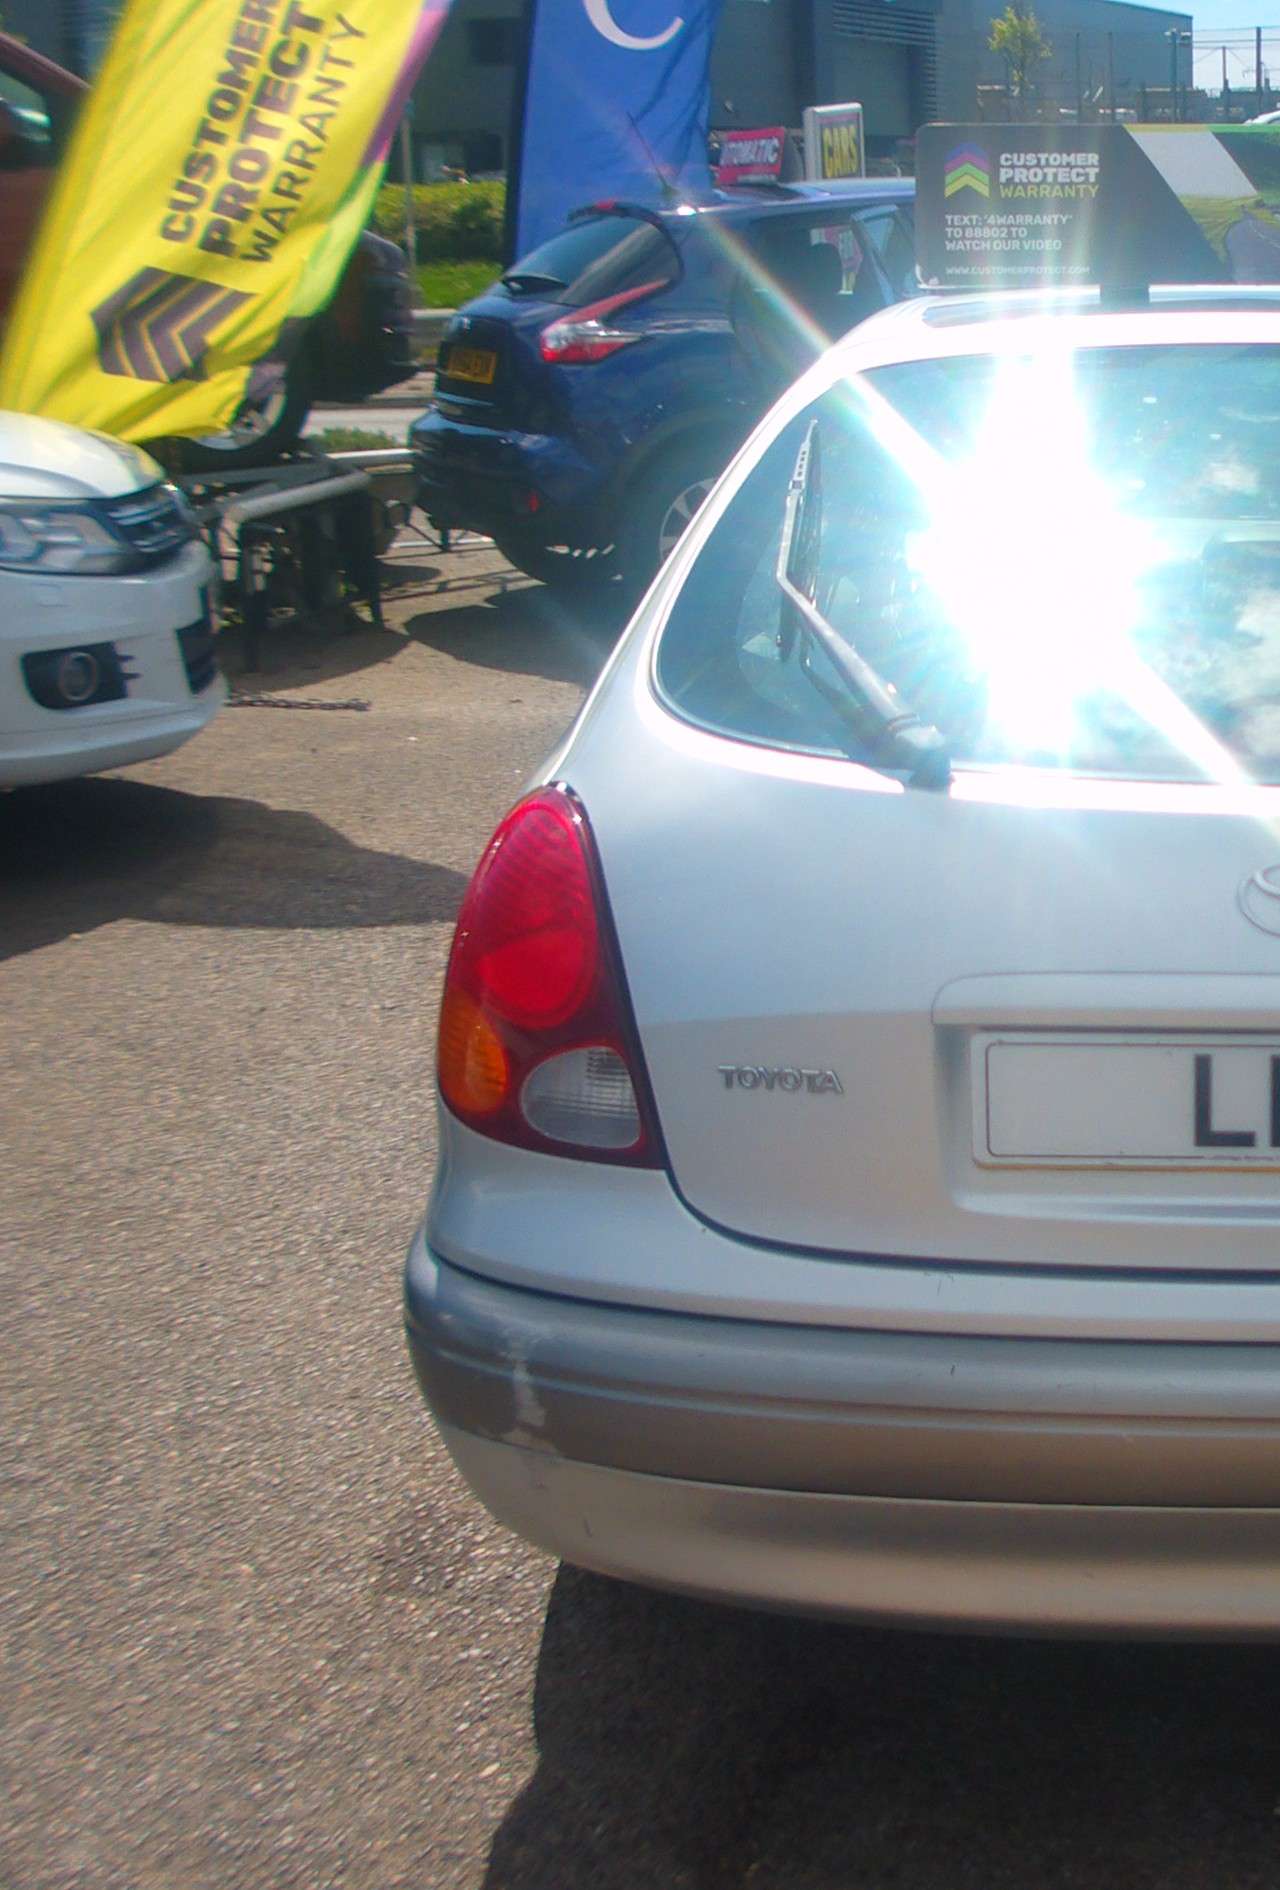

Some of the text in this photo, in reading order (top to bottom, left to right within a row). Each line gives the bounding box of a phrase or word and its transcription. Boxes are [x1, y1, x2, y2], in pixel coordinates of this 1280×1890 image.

[159, 0, 279, 242] CUSTOMER
[197, 0, 325, 258] PROTECT
[240, 13, 365, 262] WARRANTY
[1000, 153, 1099, 166] CUSTOMER
[1000, 168, 1099, 183] PROTECT
[1000, 185, 1099, 198] WARRANTY
[945, 214, 982, 225] TEXT:
[945, 227, 963, 238] TO
[1012, 227, 1028, 238] TO
[945, 239, 1062, 250] WATCH OUR VIDEO
[717, 1065, 844, 1094] TOYOTA
